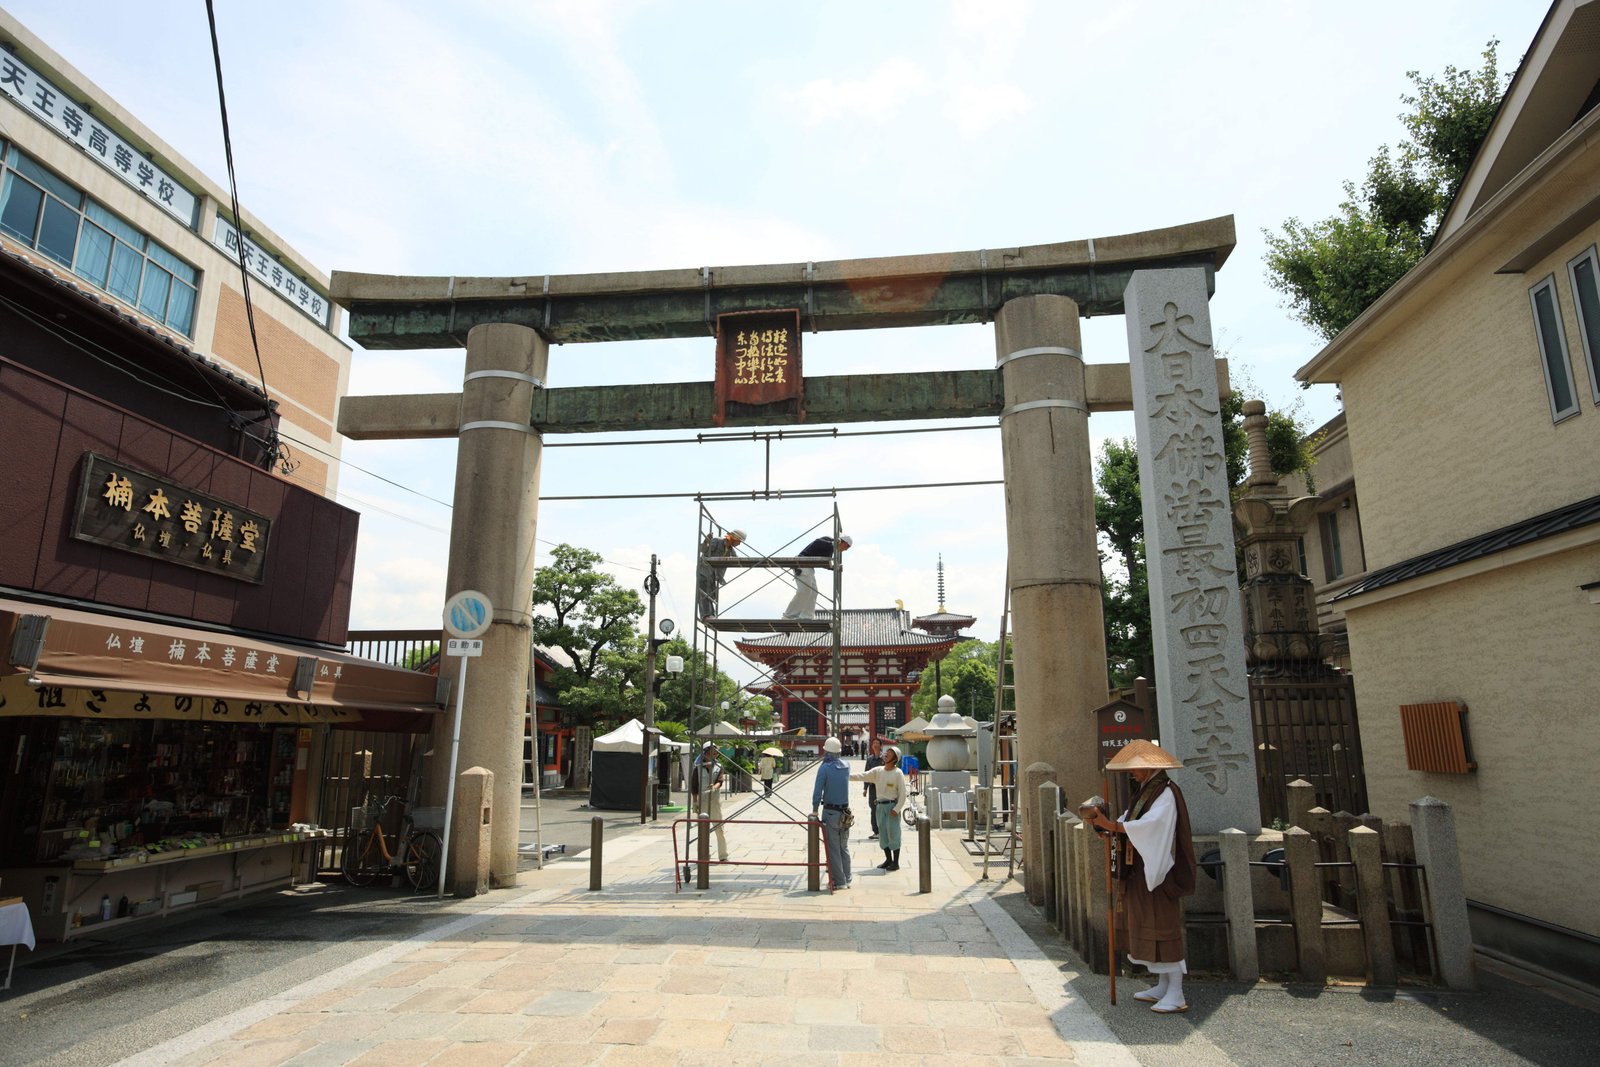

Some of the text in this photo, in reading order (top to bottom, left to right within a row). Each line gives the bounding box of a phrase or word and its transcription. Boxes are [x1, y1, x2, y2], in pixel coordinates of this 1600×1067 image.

[225, 229, 322, 317] 四天王寺中学校
[102, 472, 260, 553] 楠本菩薩堂
[105, 632, 343, 679] 仏壇 楠本菩薩堂 仏具
[448, 640, 481, 649] 自動車
